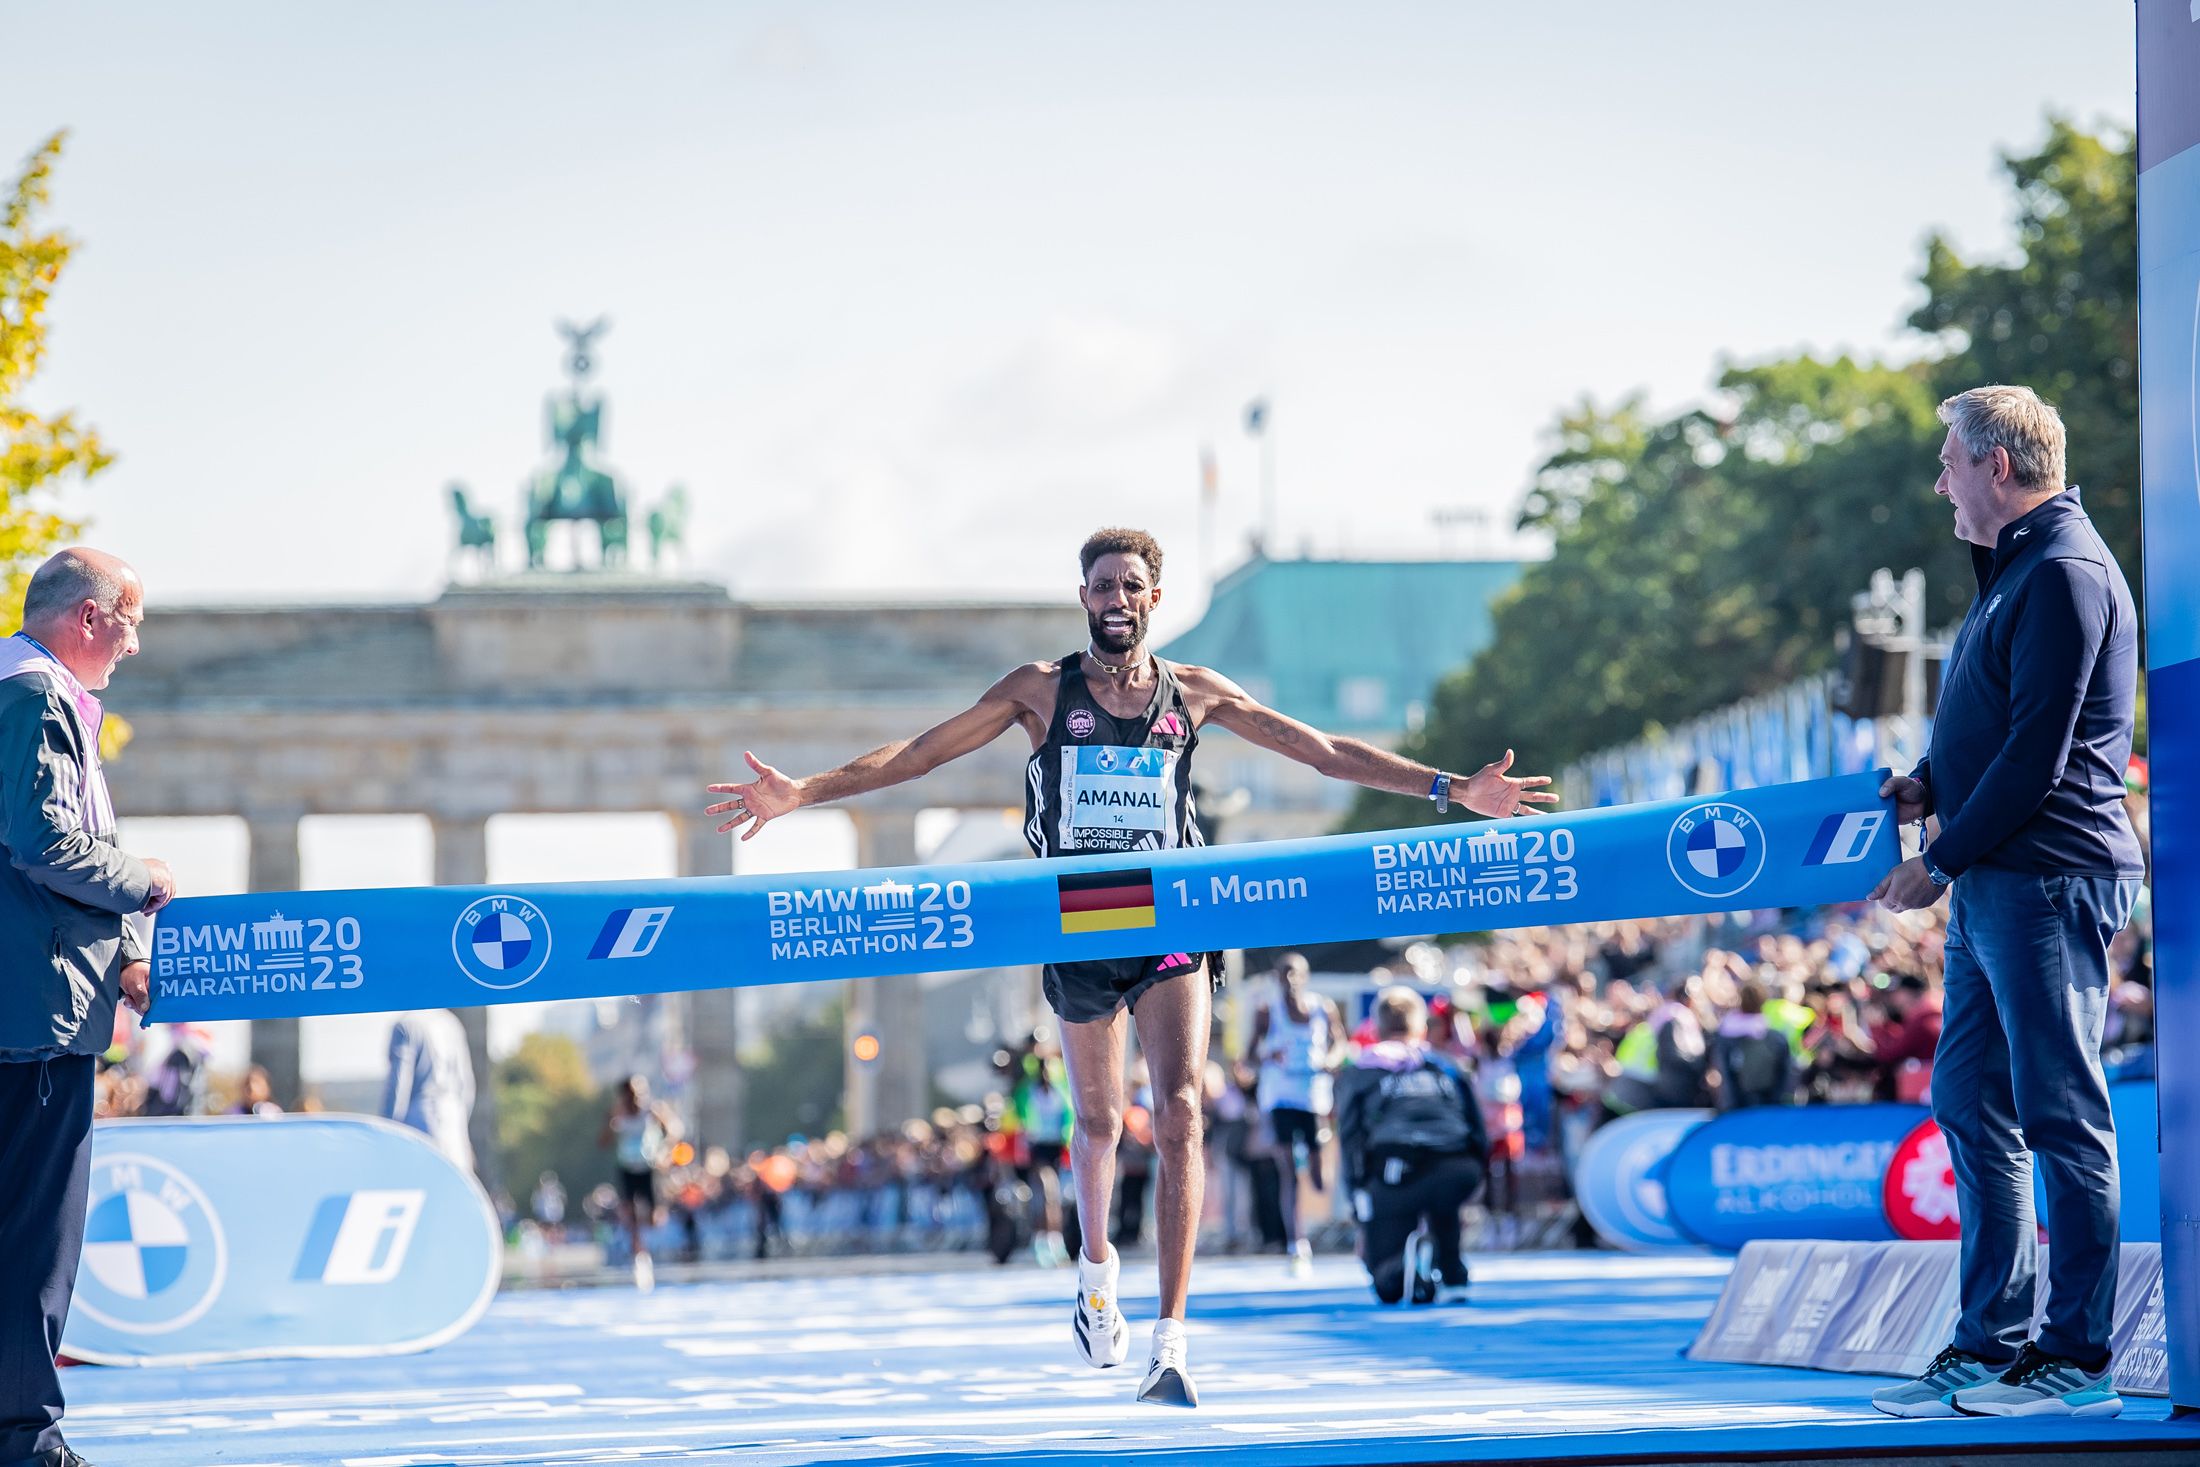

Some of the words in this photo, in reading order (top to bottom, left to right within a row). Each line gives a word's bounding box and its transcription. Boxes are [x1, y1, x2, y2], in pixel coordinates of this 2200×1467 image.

[1077, 790, 1161, 808] AMANAL
[1113, 815, 1123, 823] 14
[1679, 806, 1750, 834] BMW
[1074, 829, 1134, 840] IMPOSSIBLE
[1075, 839, 1083, 848] IS
[1084, 840, 1130, 850] NOTHING
[1521, 828, 1575, 864] 20
[1372, 838, 1462, 870] BMW
[1172, 879, 1199, 907] 1.
[1210, 875, 1307, 905] Mann
[1375, 867, 1467, 892] BERLIN
[1525, 865, 1579, 903] 23
[767, 887, 859, 917] BMW
[918, 880, 972, 912] 20
[1377, 885, 1521, 915] MARATHON
[465, 899, 537, 927] BMW
[770, 914, 862, 939] BERLIN
[156, 923, 247, 955] BMW
[307, 917, 361, 952] 20
[771, 933, 917, 961] MARATHON
[921, 914, 975, 950] 23
[158, 953, 250, 977] BERLIN
[310, 954, 364, 991] 23
[160, 972, 306, 998] MARATHON
[92, 1164, 193, 1211] MW
